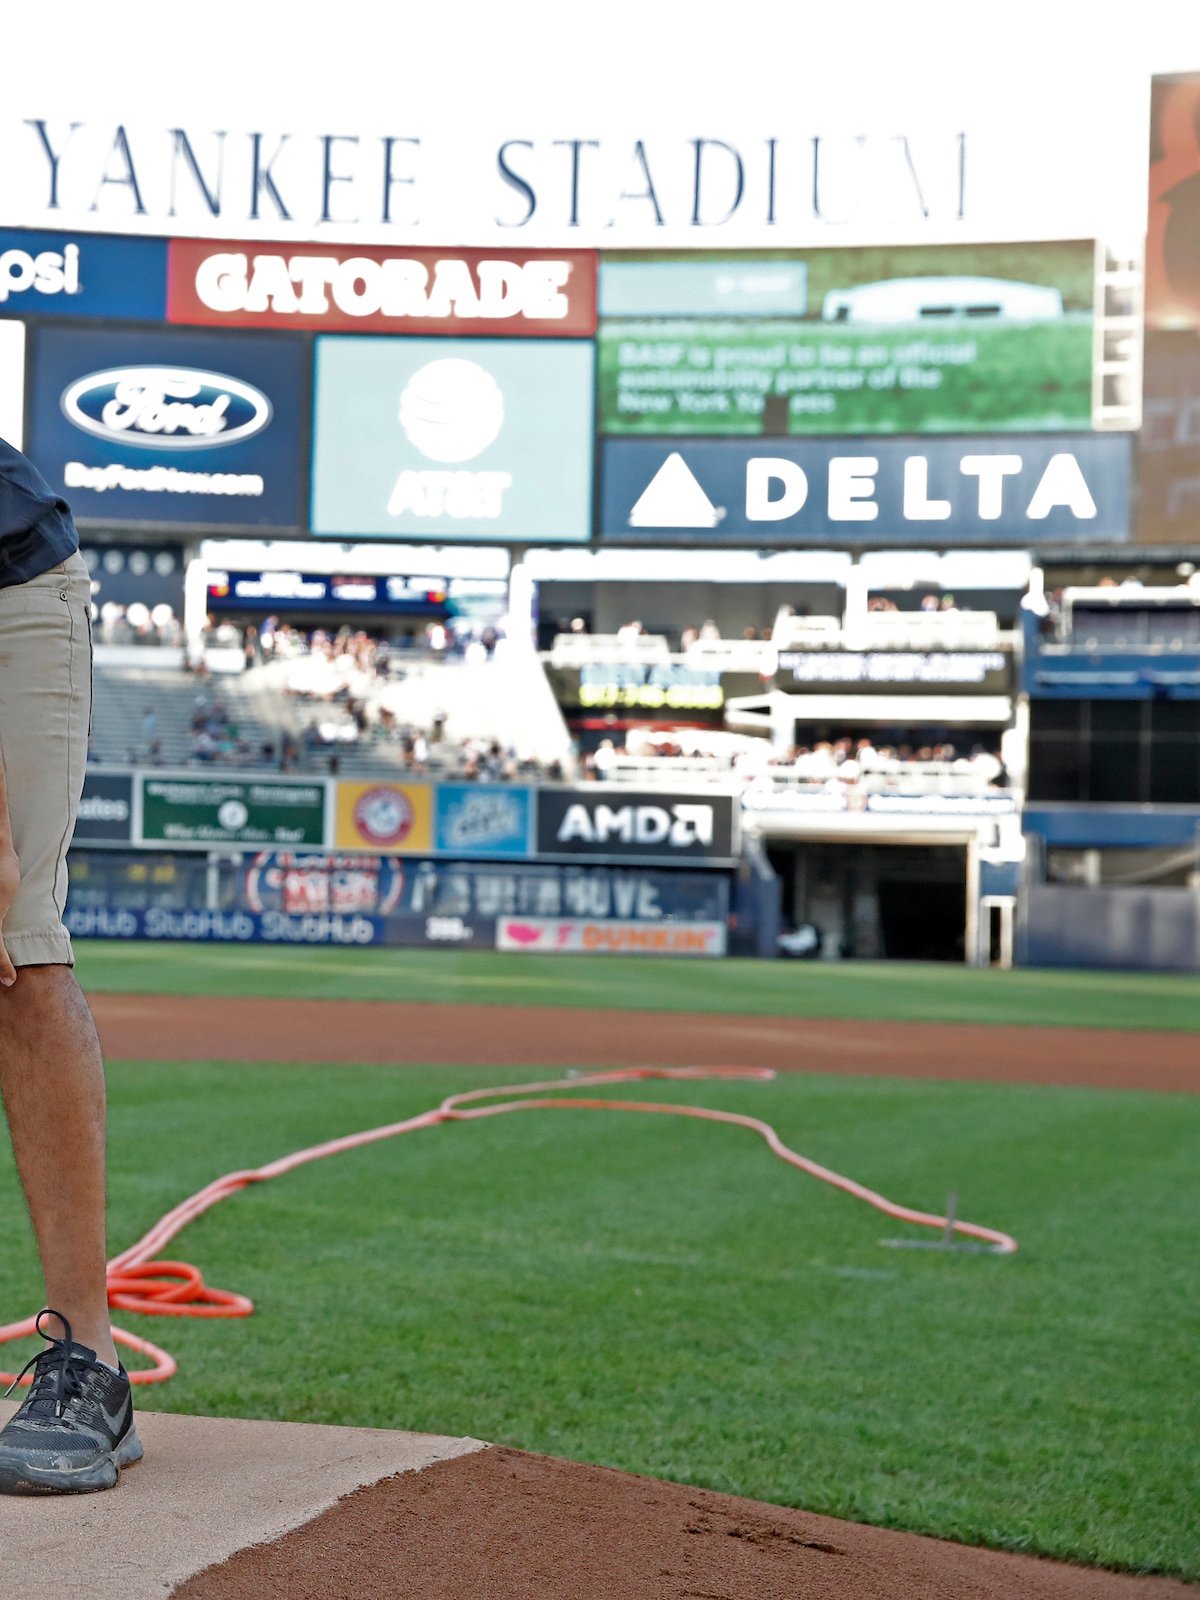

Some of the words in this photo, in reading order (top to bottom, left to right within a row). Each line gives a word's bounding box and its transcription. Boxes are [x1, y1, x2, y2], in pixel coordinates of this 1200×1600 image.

[22, 118, 421, 226] YANKEE
[494, 131, 968, 229] STADIUM
[195, 252, 571, 319] GATORADE
[102, 381, 231, 435] Ford
[746, 453, 1098, 522] DELTA
[557, 804, 672, 843] AMD
